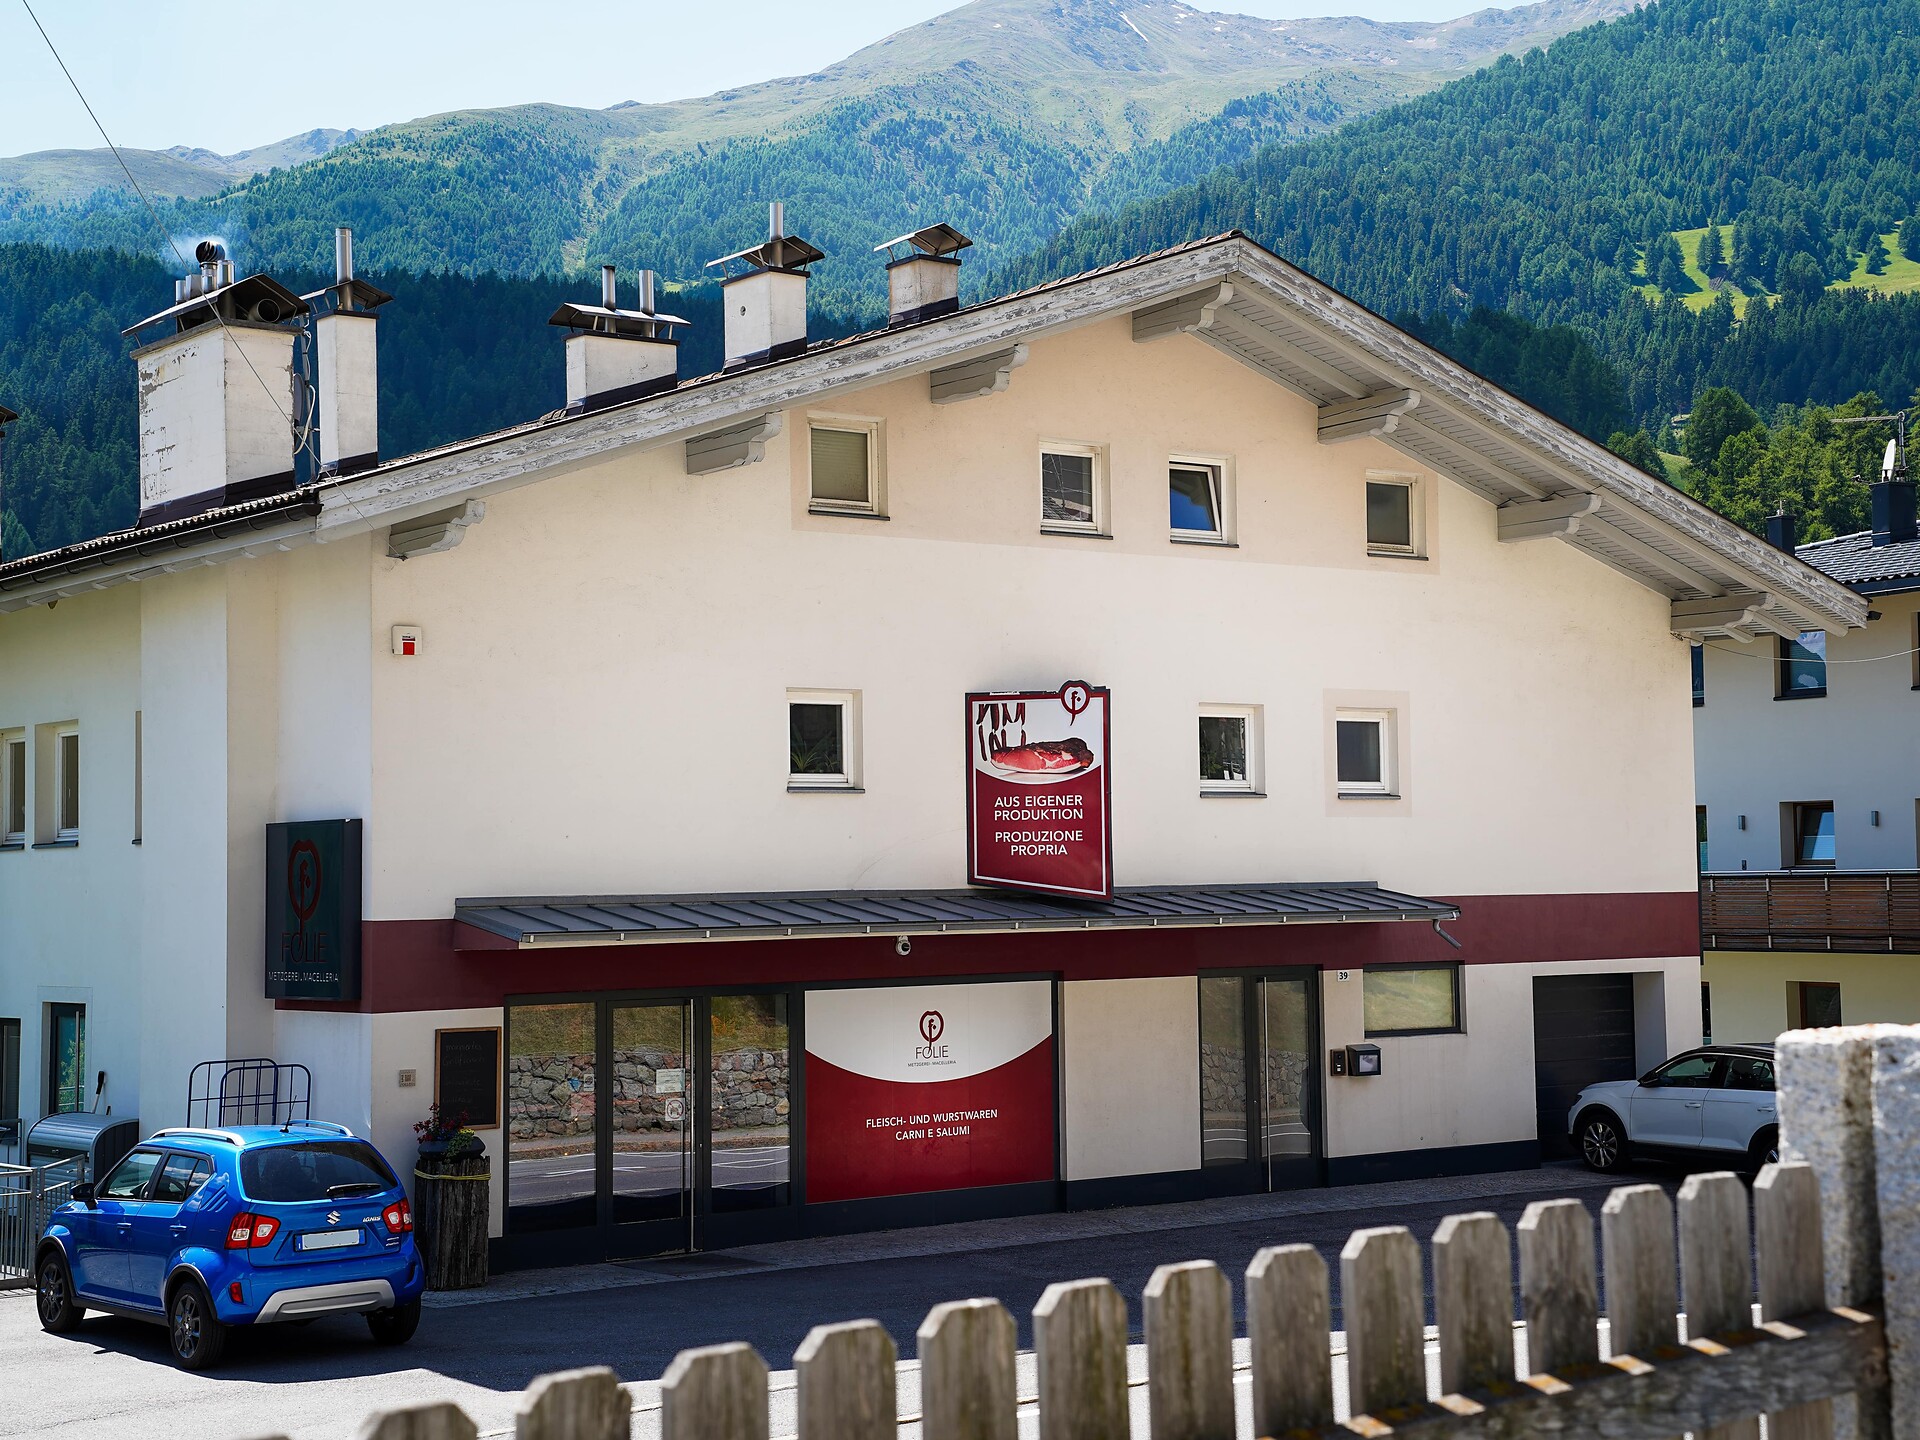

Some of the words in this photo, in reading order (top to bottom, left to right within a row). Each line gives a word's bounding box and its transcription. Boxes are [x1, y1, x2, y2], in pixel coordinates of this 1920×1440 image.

[994, 796, 1020, 808] AUS
[1025, 795, 1083, 807] EIGENER
[994, 808, 1084, 821] PRODUKTION
[995, 830, 1084, 843] PRODUZIONE
[1010, 844, 1068, 856] PROPRIA
[281, 931, 328, 963] FOLIE
[1339, 971, 1348, 980] 39
[915, 1045, 949, 1059] FOLIE
[866, 1117, 906, 1128] FLEISCH-
[909, 1115, 930, 1126] UND
[933, 1108, 998, 1123] WURSTWAREN
[895, 1129, 925, 1141] CARNI
[928, 1129, 934, 1138] E
[936, 1125, 970, 1137] SALUMI
